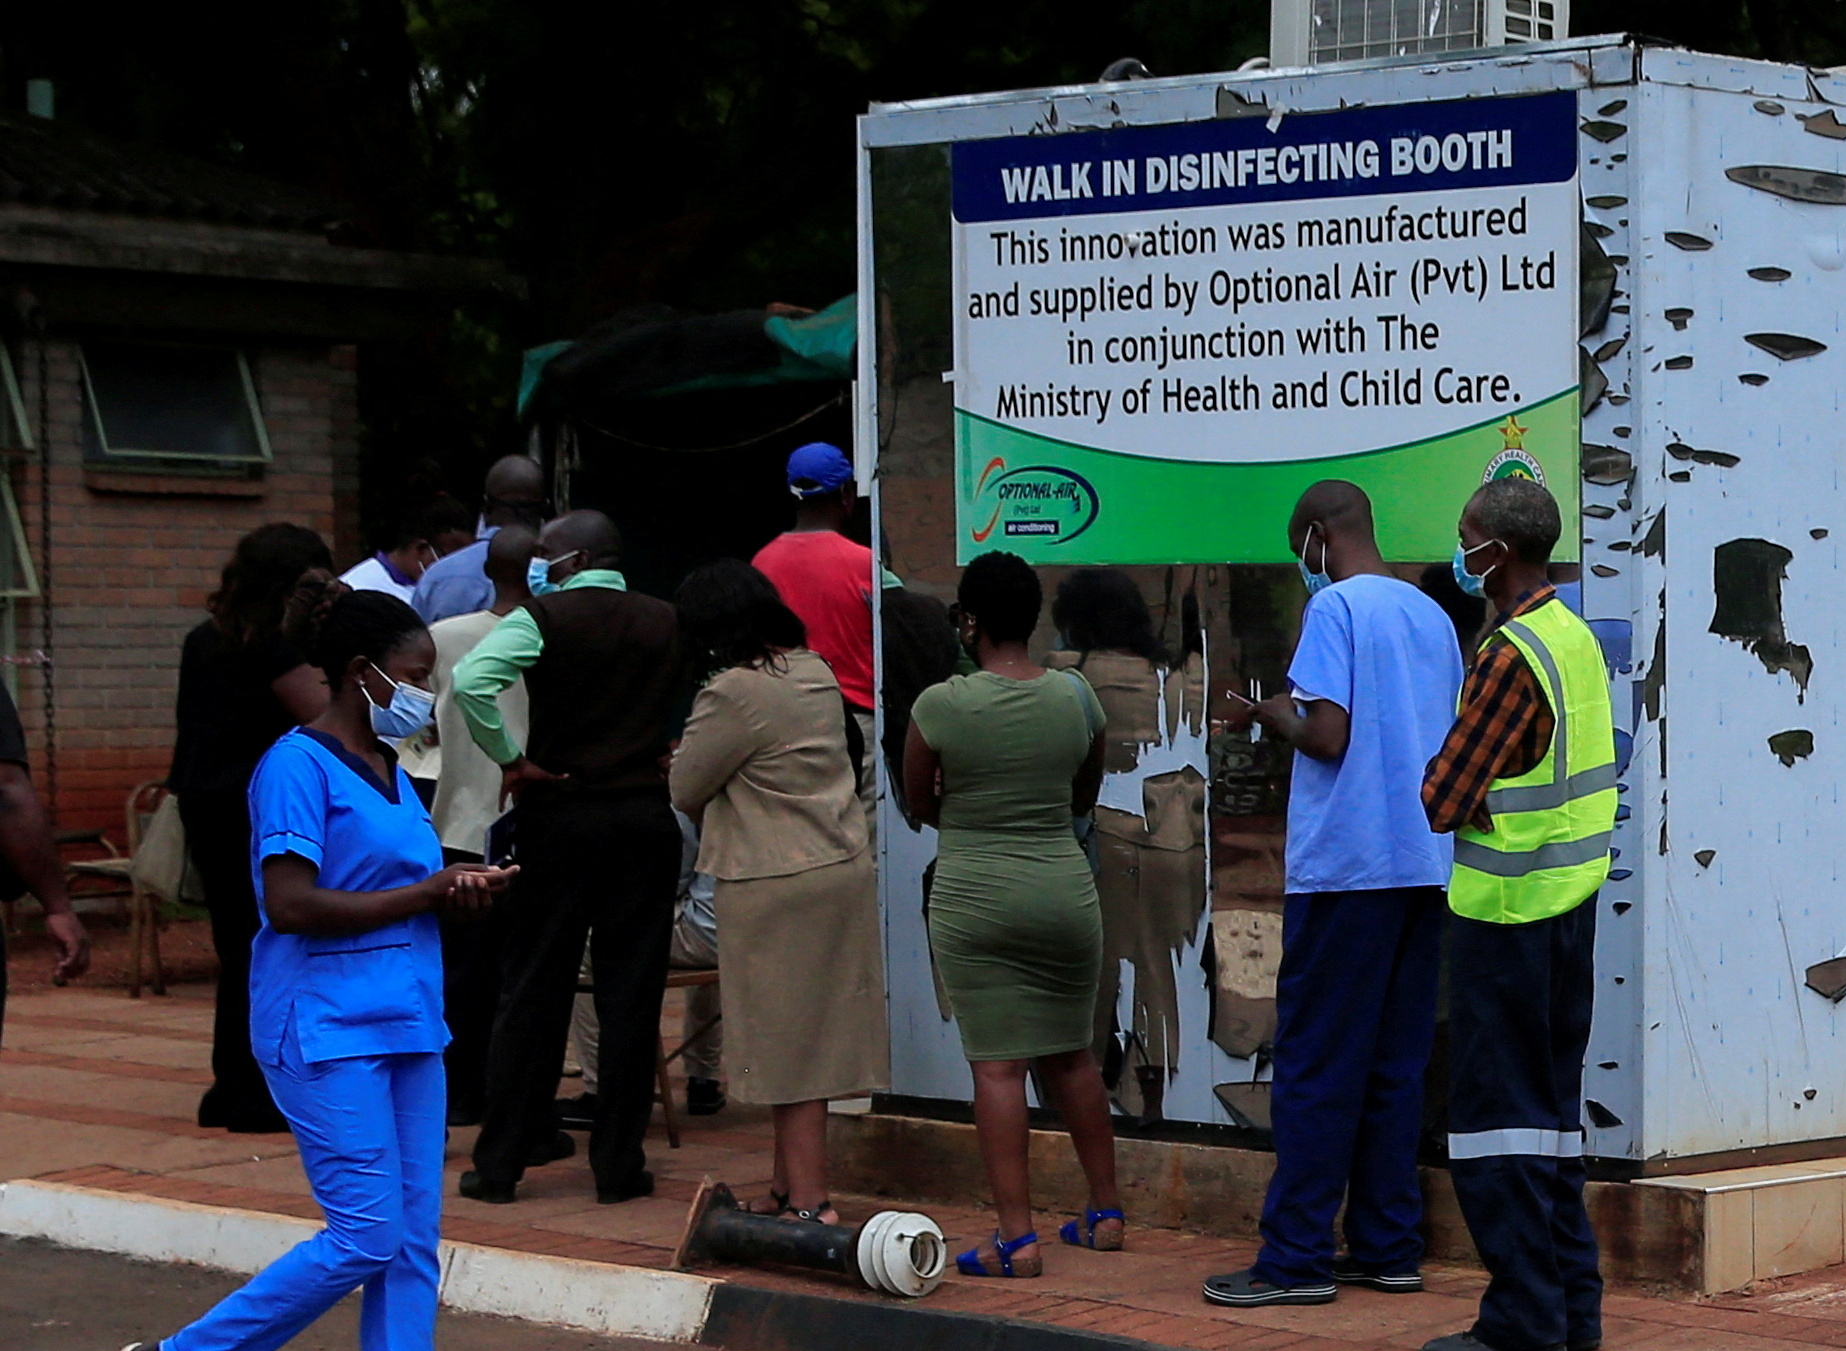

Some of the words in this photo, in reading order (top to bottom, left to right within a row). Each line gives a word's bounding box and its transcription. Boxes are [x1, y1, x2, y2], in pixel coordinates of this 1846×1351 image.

[1001, 161, 1093, 204] WALK
[1102, 159, 1135, 196] IN
[1146, 139, 1380, 194] DISINFECTING
[1391, 129, 1512, 176] BOOTH
[990, 230, 1049, 266] This
[1228, 222, 1285, 251] was
[1297, 196, 1527, 247] manufactured
[969, 281, 1019, 319] and
[1030, 274, 1152, 323] supplied
[1165, 272, 1198, 316] by
[1210, 263, 1340, 314] Optional
[1351, 261, 1397, 298] Air
[1411, 255, 1487, 305] (Pvt)
[1502, 250, 1555, 291] Ltd
[1067, 330, 1093, 365] in
[1105, 322, 1285, 370] conjunction
[1297, 316, 1365, 355] with
[1377, 313, 1439, 351] The
[996, 383, 1111, 425] Ministry
[1122, 378, 1152, 414] of
[1163, 375, 1260, 413] Health
[1272, 371, 1328, 408] and
[1341, 367, 1421, 406] Child
[1434, 367, 1521, 404] Care.
[998, 482, 1079, 501] OPTIONAL-AIR
[1008, 523, 1016, 532] air
[1017, 523, 1055, 534] conditioning
